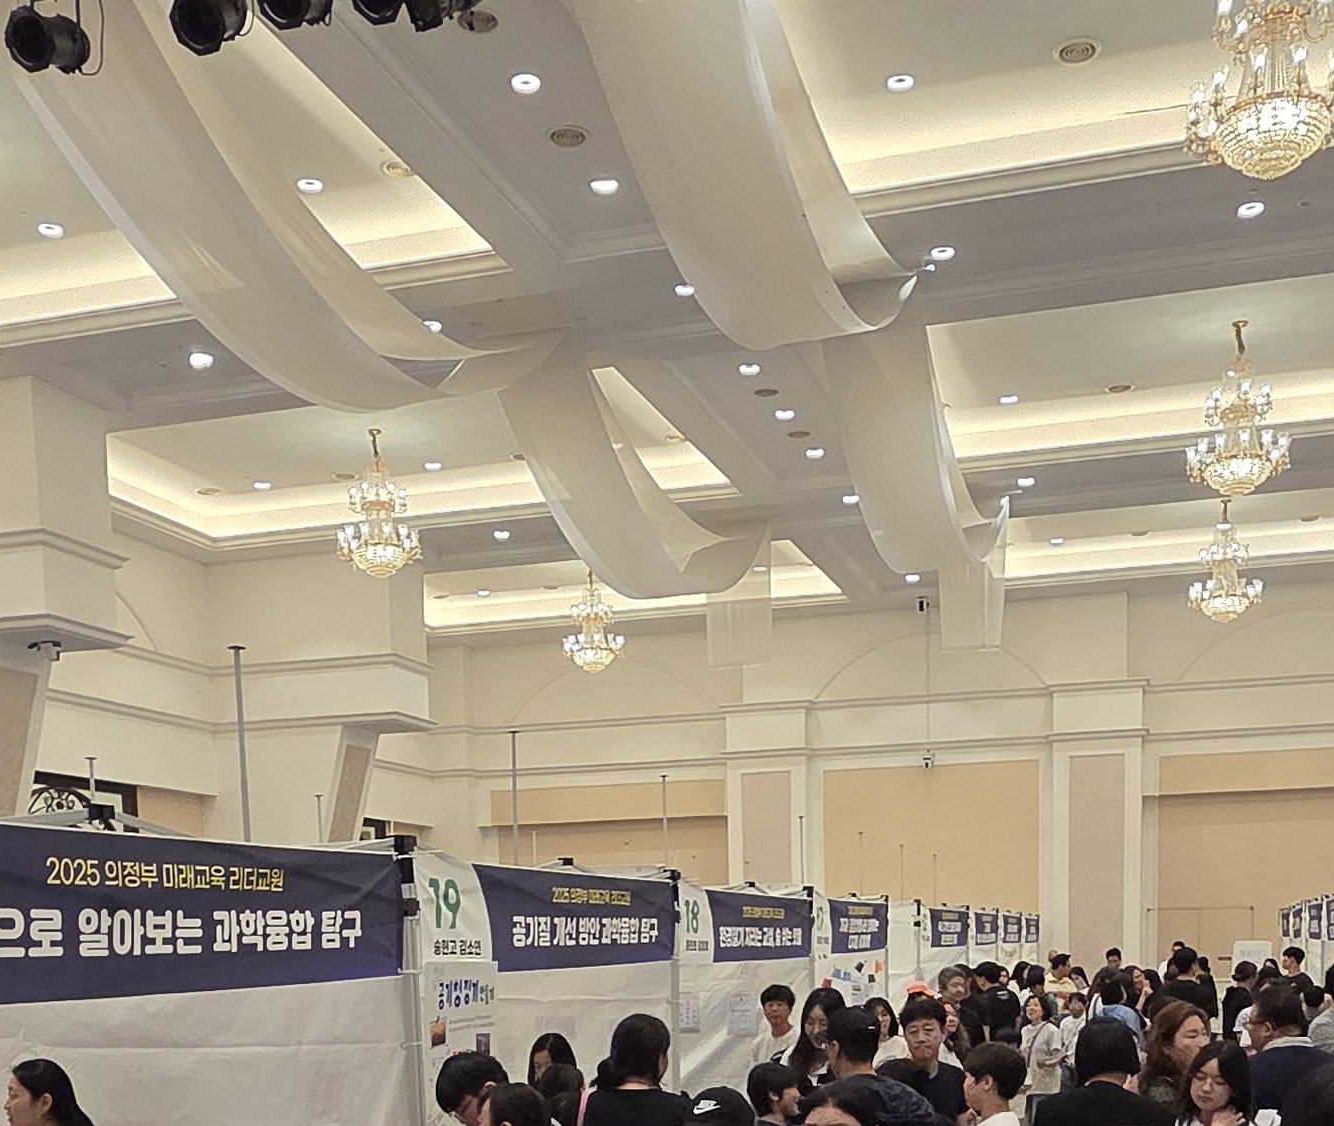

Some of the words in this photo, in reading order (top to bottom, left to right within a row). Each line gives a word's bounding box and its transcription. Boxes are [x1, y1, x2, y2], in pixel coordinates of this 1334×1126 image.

[46, 857, 100, 885] 2025
[104, 861, 159, 889] 의정부
[162, 863, 226, 891] 미래교육
[229, 866, 285, 893] 리더교원
[429, 877, 462, 930] 19
[684, 900, 700, 933] 18
[78, 908, 203, 957] 알아보는
[213, 909, 315, 952] 과학융합
[320, 910, 363, 949] 탐구
[512, 916, 551, 947] 공기질
[553, 917, 577, 946] 개선
[579, 917, 600, 945] 방안
[641, 918, 659, 943] 탐구
